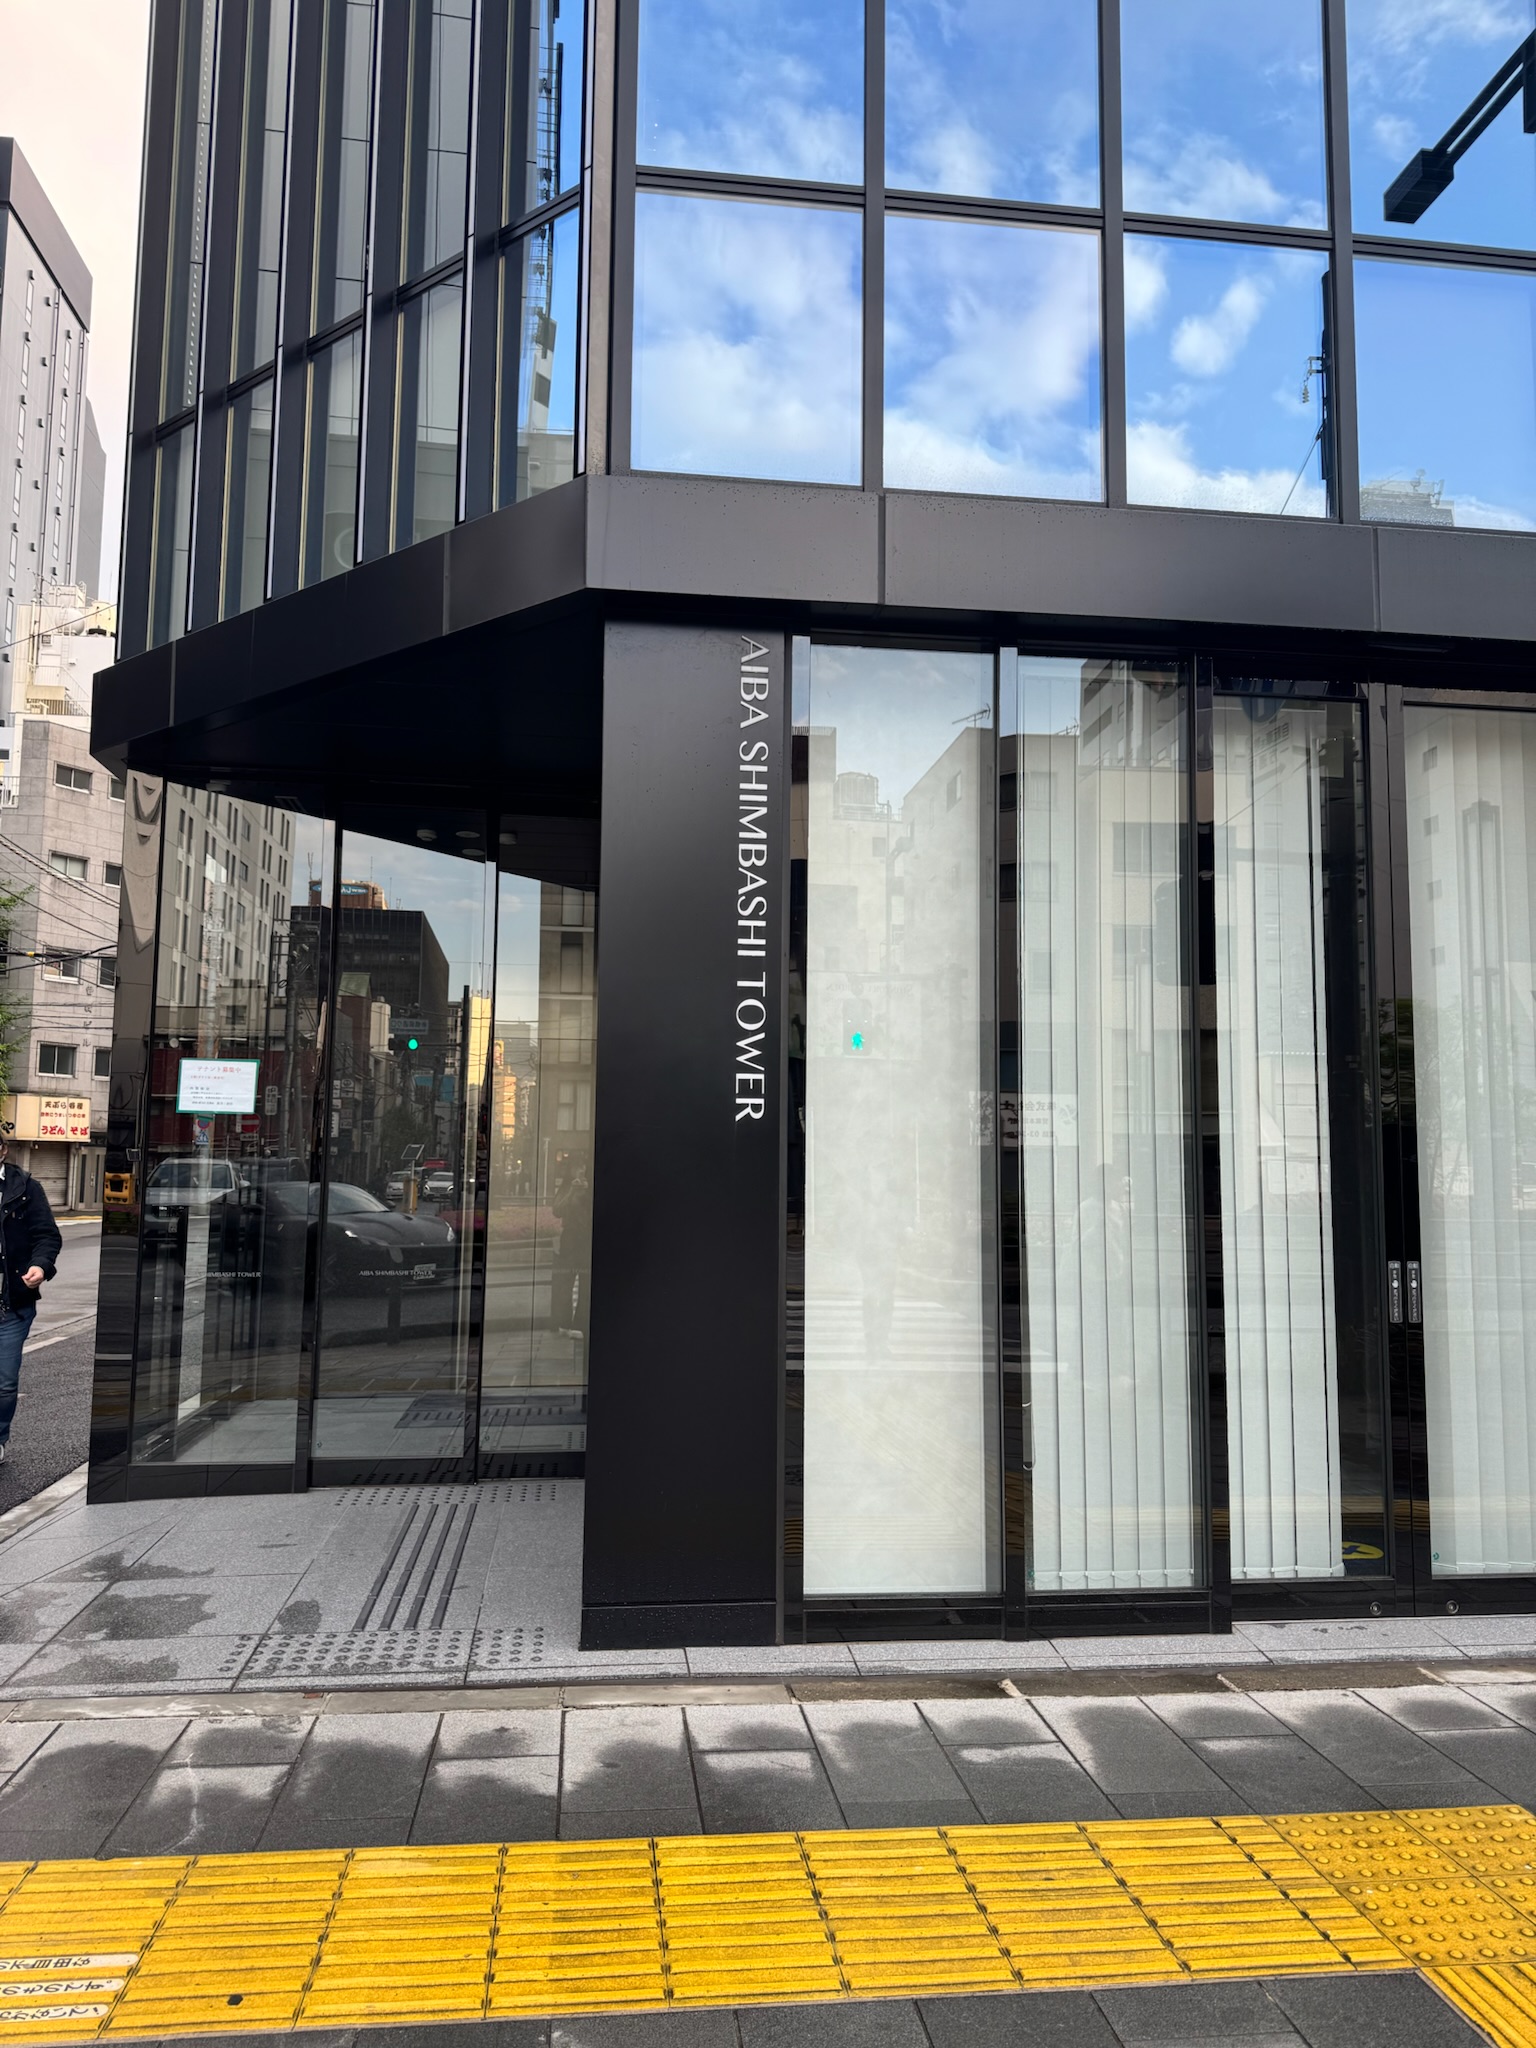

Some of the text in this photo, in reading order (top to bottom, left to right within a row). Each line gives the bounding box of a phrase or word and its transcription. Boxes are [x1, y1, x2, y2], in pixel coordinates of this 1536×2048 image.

[735, 635, 770, 1122] AIBA SHIMBASHI TOWER
[41, 1125, 89, 1136] うどん そば
